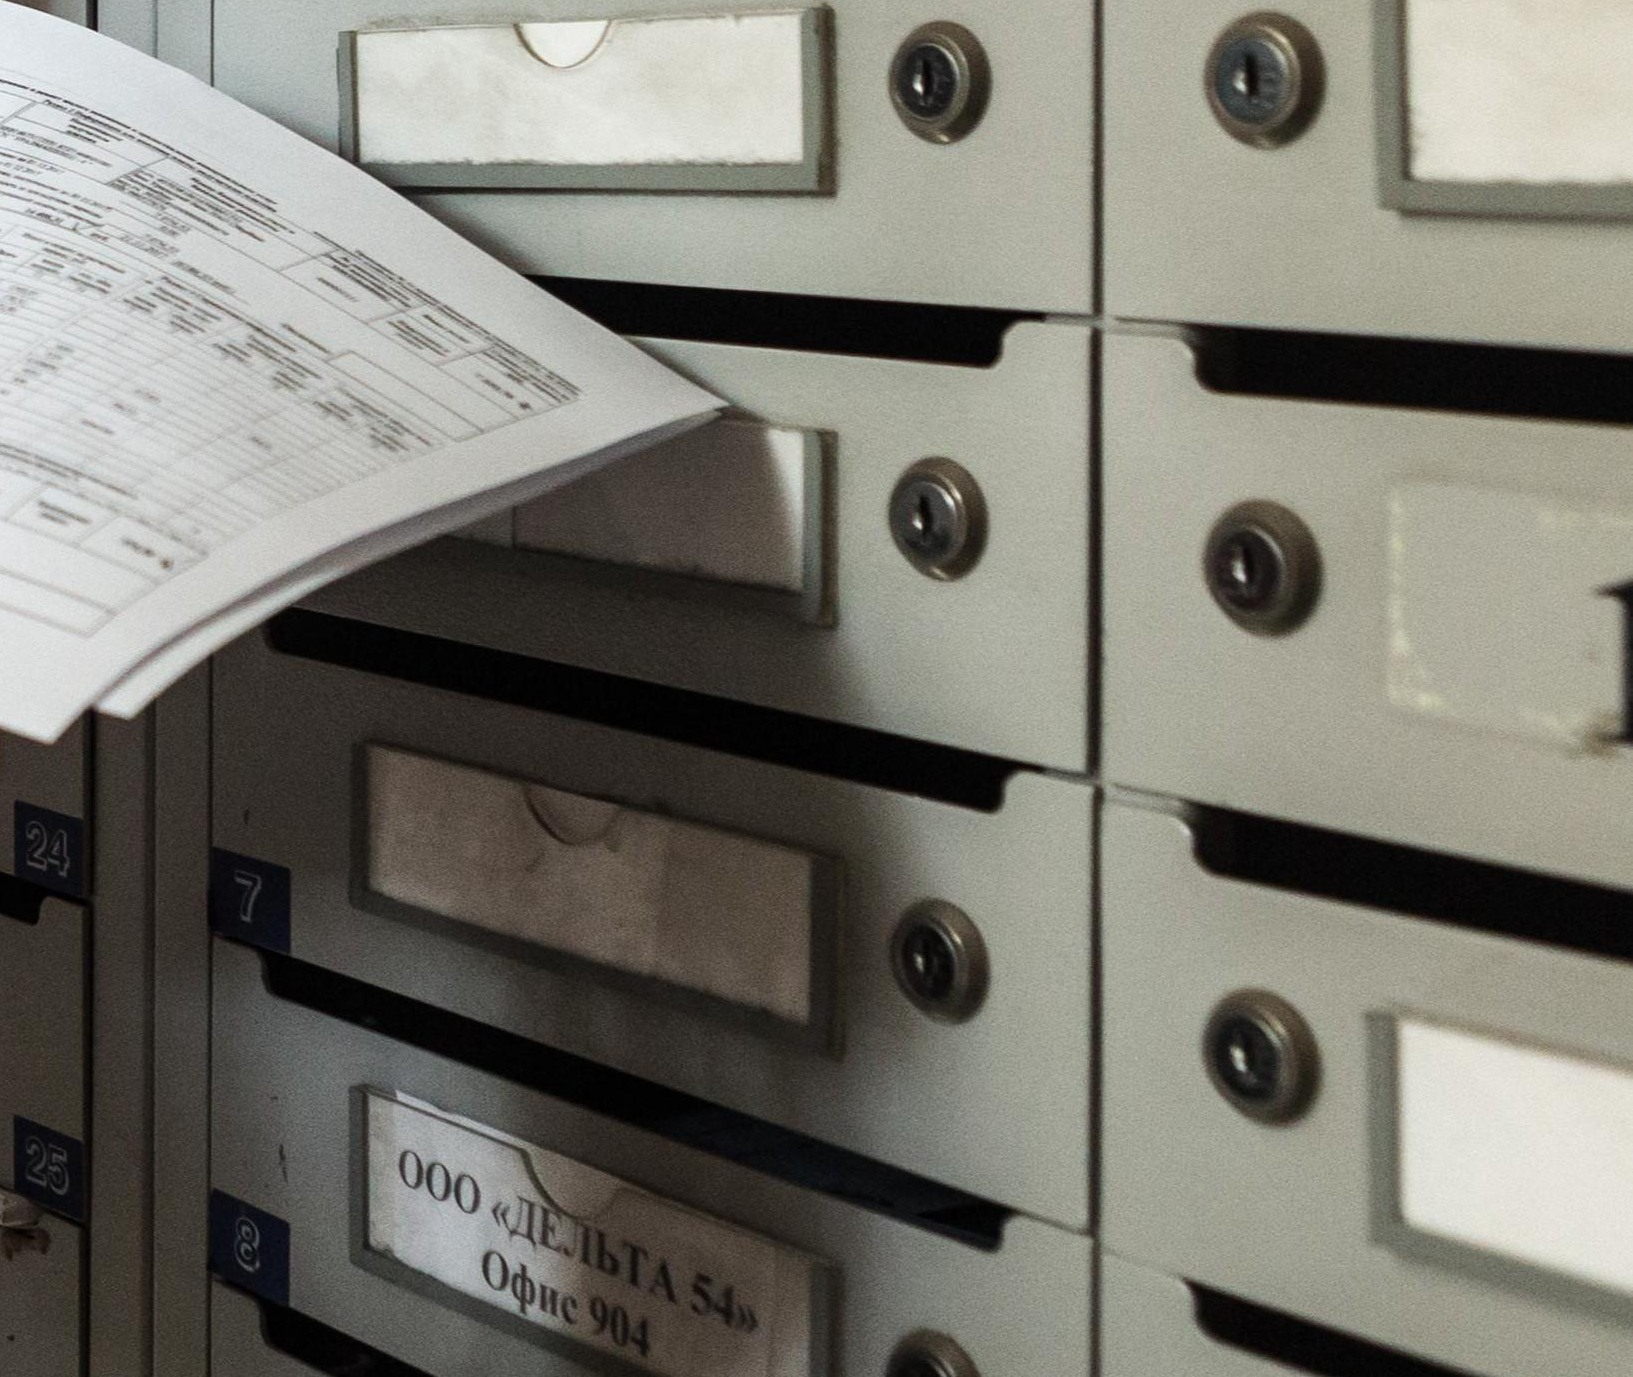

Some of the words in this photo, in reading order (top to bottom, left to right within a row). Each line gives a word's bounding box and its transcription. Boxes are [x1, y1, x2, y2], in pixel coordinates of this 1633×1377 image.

[25, 821, 70, 878] 24
[235, 868, 262, 923] 7
[25, 1136, 70, 1196] 25
[235, 1216, 260, 1273] 8
[398, 1148, 483, 1217] ООО
[490, 1195, 678, 1301] «ДЕЛЬТА
[690, 1275, 761, 1335] 54»
[480, 1248, 581, 1323] Офис
[589, 1295, 653, 1358] 904
